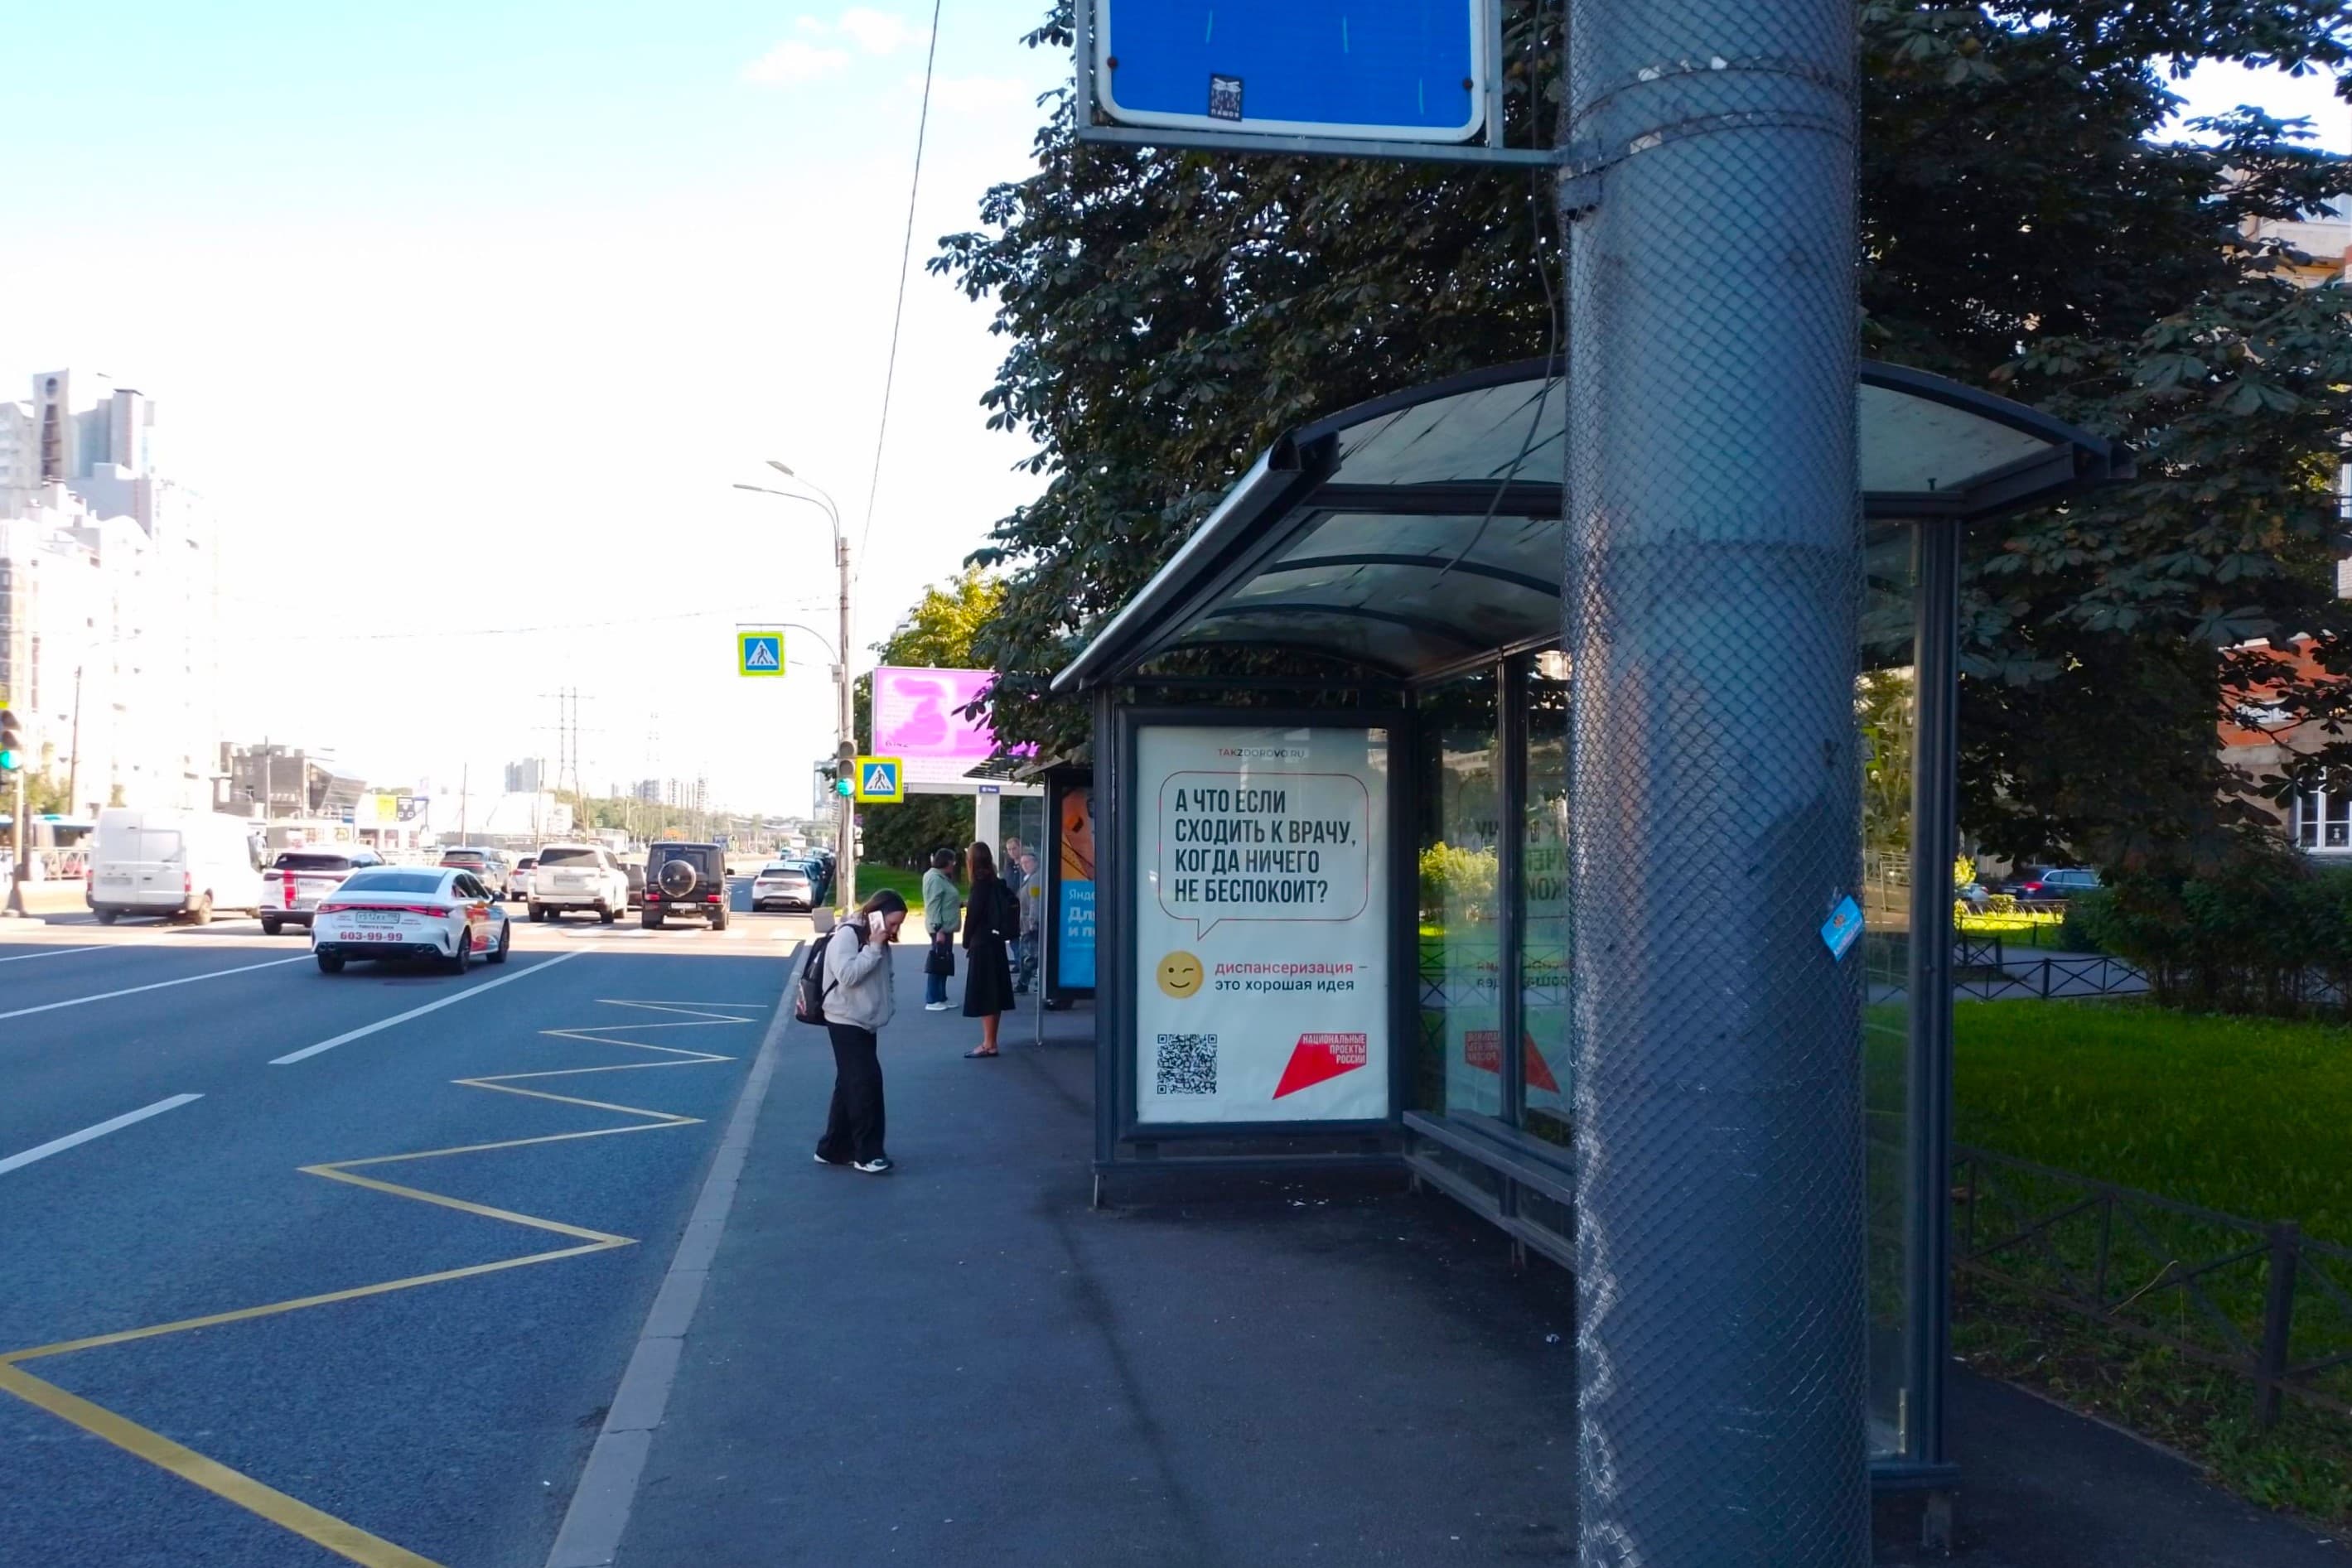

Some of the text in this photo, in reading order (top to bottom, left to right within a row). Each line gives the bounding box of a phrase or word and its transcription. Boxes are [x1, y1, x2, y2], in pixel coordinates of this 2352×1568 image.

[1219, 748, 1305, 759] TAKZDOROVO.RU
[1176, 789, 1286, 813] А ЧТО ЕСЛИ
[1176, 818, 1356, 847] СХОДИТЬ К ВРАЧУ,
[1176, 849, 1320, 875] КОГДА НИЧЕГО
[1175, 879, 1328, 903] НЕ БЕСПОКОИТ?
[340, 931, 403, 942] 603-99-99
[1215, 963, 1354, 977] диспансеризация
[1215, 979, 1355, 993] это хорошая идея
[1302, 1035, 1365, 1045] НАЦИОНАЛЬНЫЕ
[1330, 1045, 1366, 1054] ПРОЕКТЫ
[1335, 1054, 1366, 1064] РОССИИ
